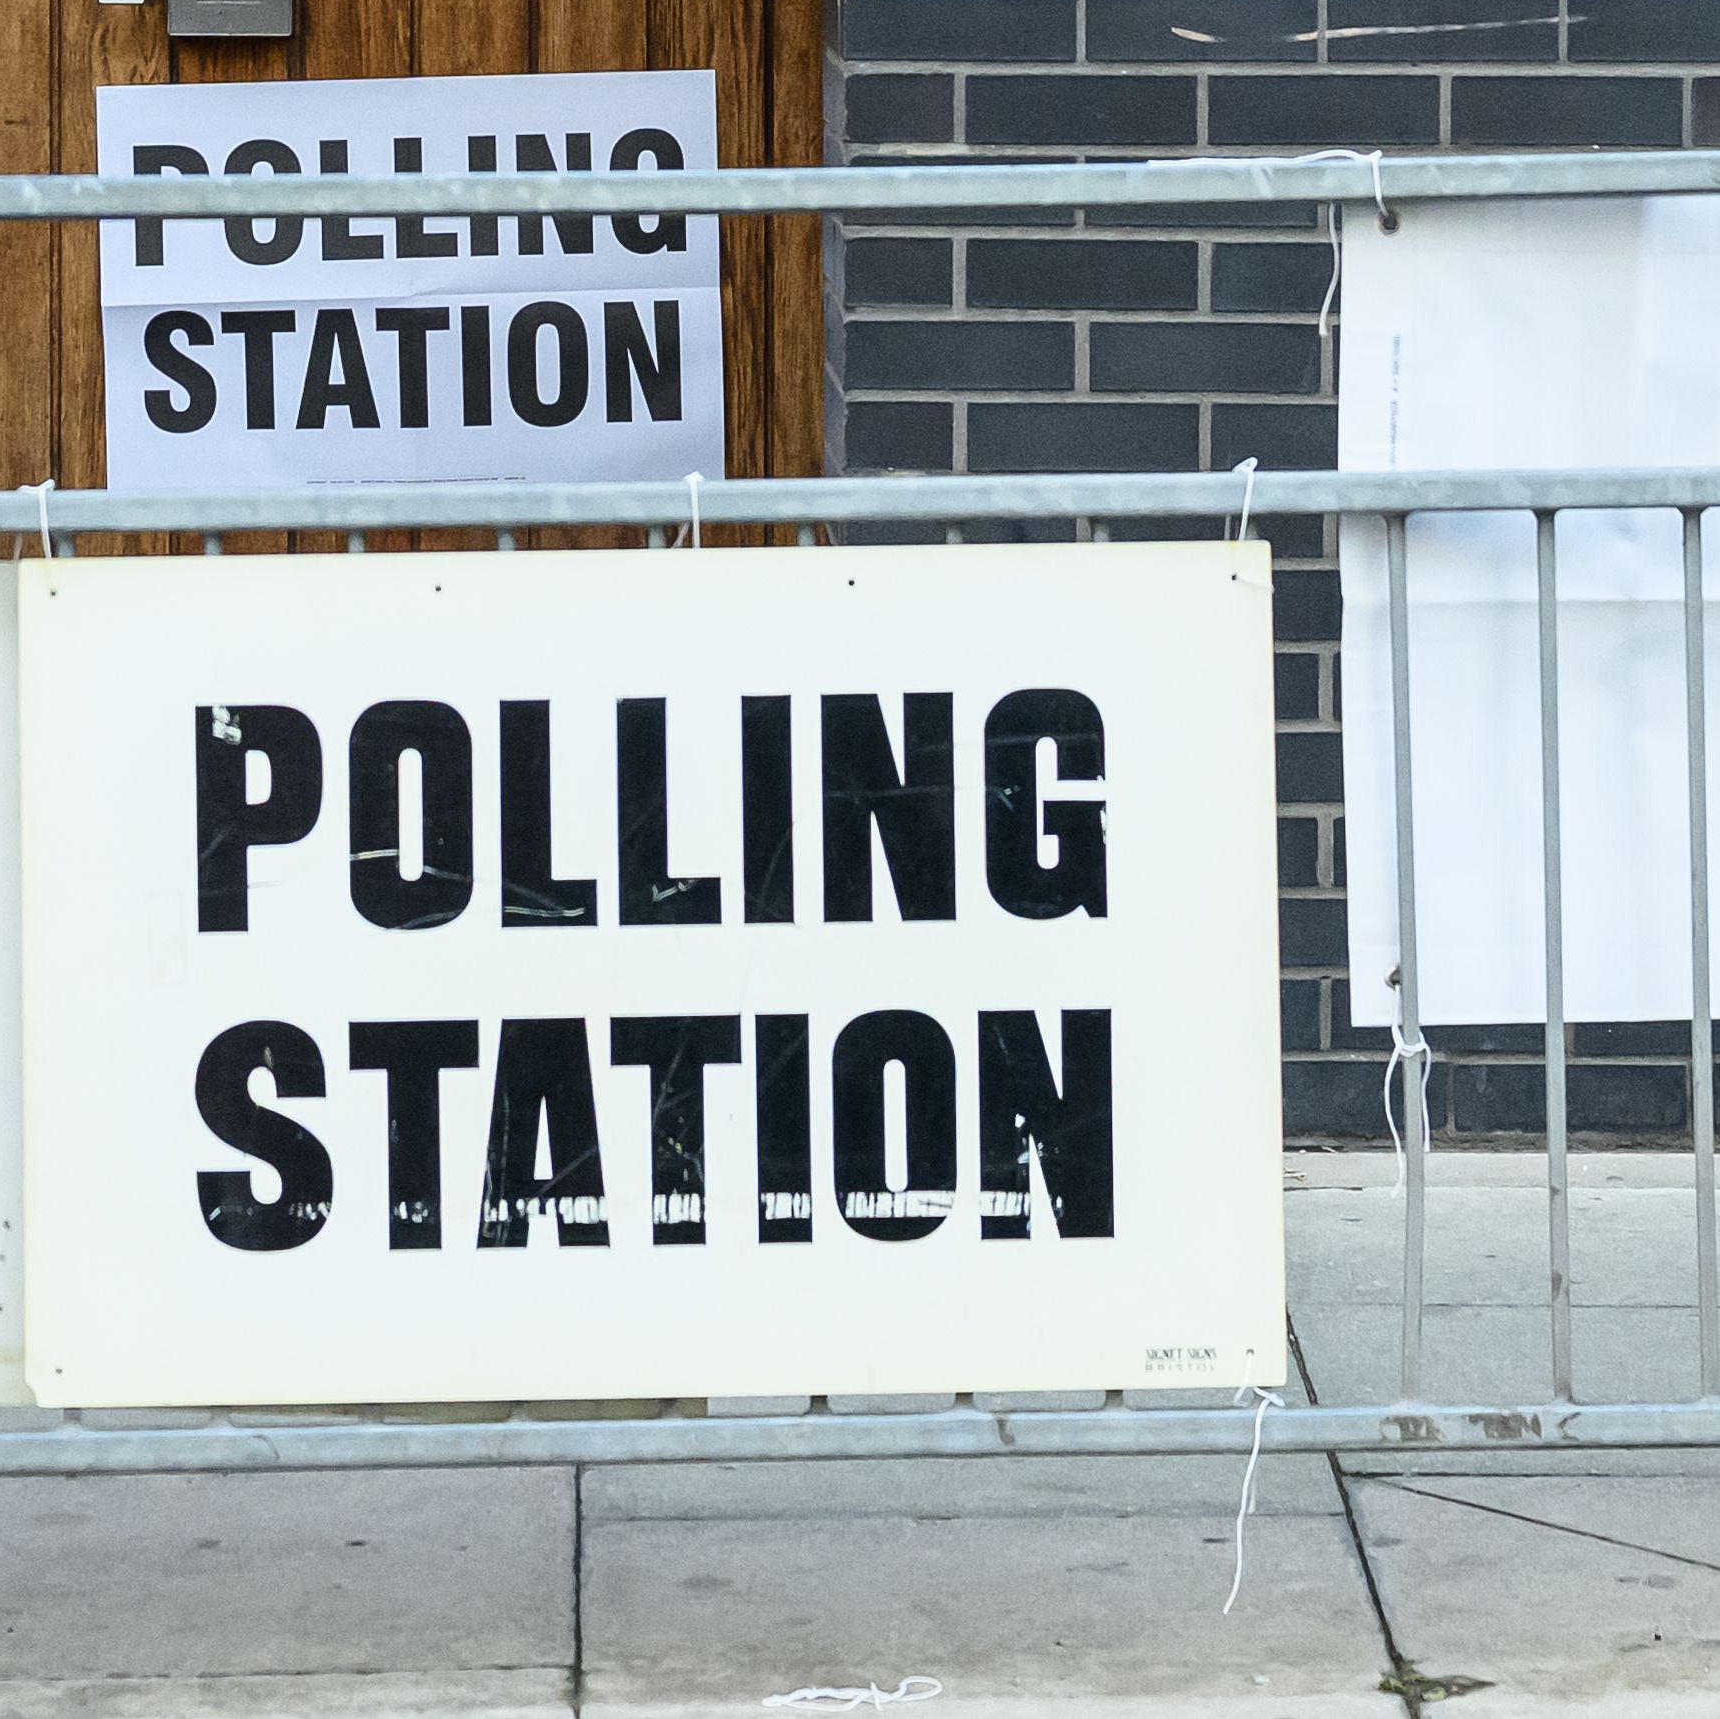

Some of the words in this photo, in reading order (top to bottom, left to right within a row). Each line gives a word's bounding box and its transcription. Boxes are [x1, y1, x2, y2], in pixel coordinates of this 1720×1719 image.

[132, 128, 687, 266] POLLING
[143, 299, 683, 434] STATION
[194, 688, 1108, 933] POLLING
[194, 1009, 1115, 1251] STATION
